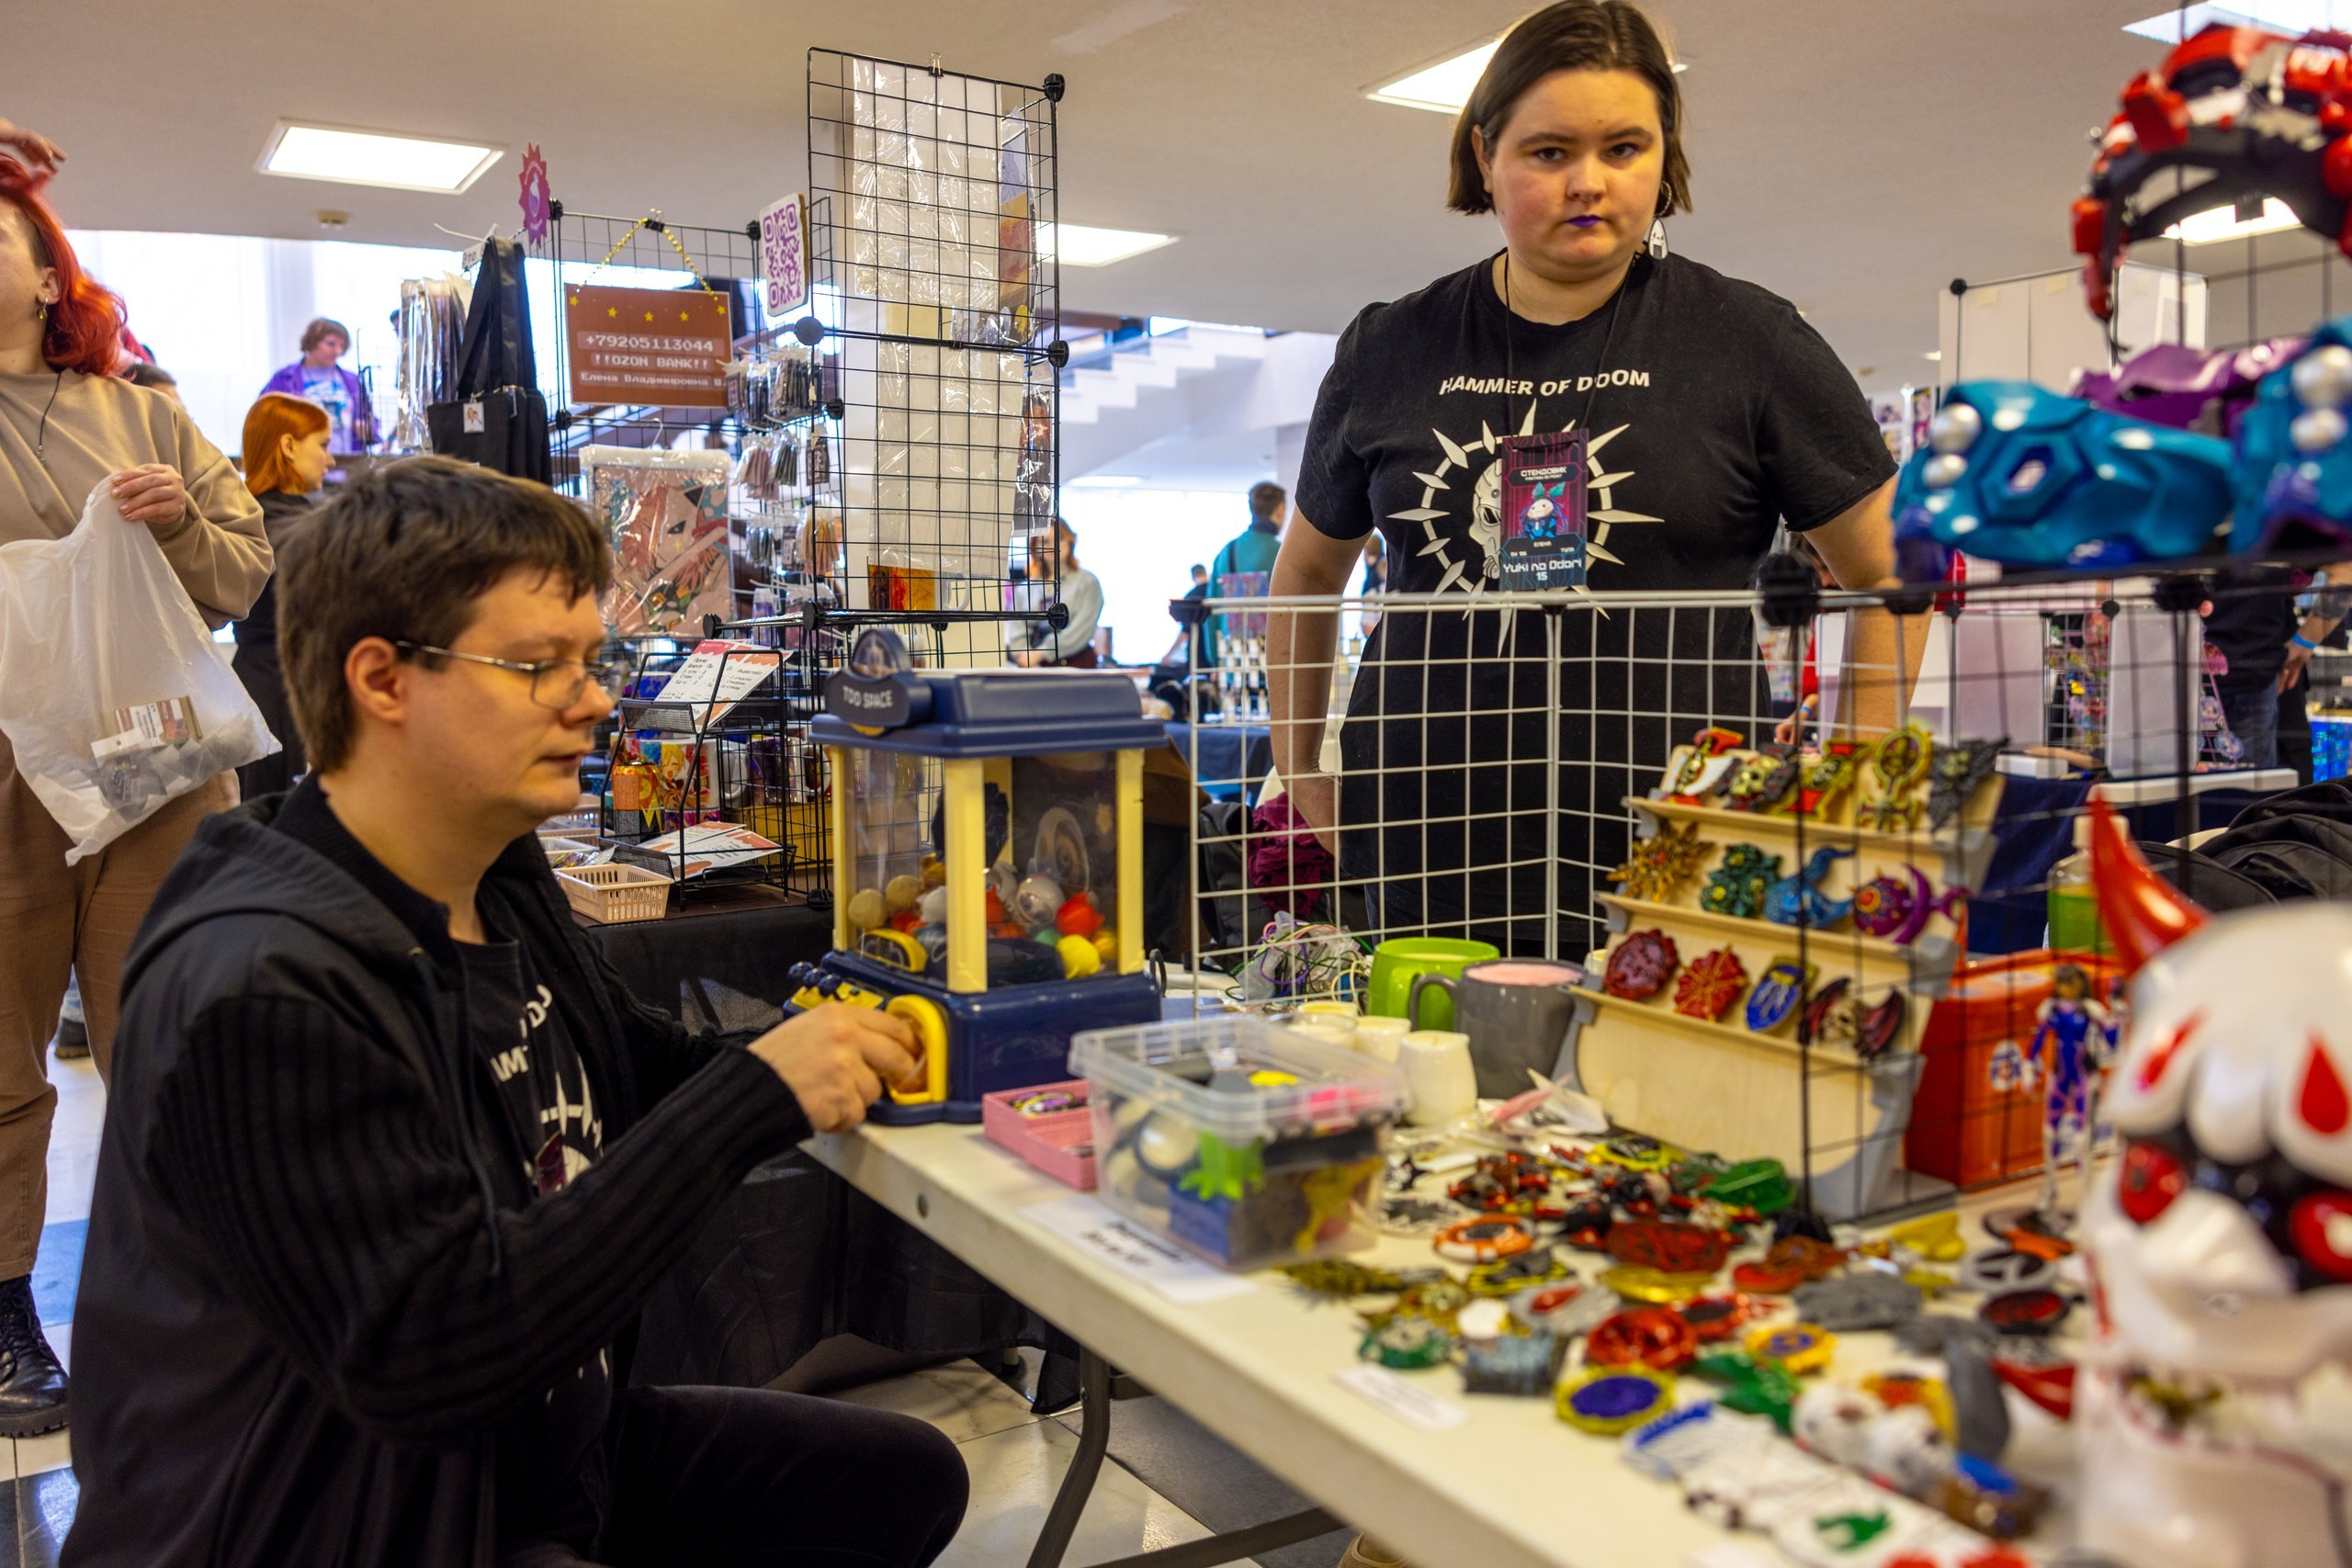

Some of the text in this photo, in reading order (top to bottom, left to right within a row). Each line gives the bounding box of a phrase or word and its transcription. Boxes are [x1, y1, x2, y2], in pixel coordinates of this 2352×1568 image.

[586, 334, 714, 353] +79205113044
[595, 354, 708, 369] !!OZON BANK!!
[581, 372, 618, 383] Елена
[624, 374, 708, 386] Владимировна
[1439, 369, 1650, 397] HAMMER OF DOOM
[1503, 562, 1529, 573] Yuki
[1535, 571, 1548, 581] 15
